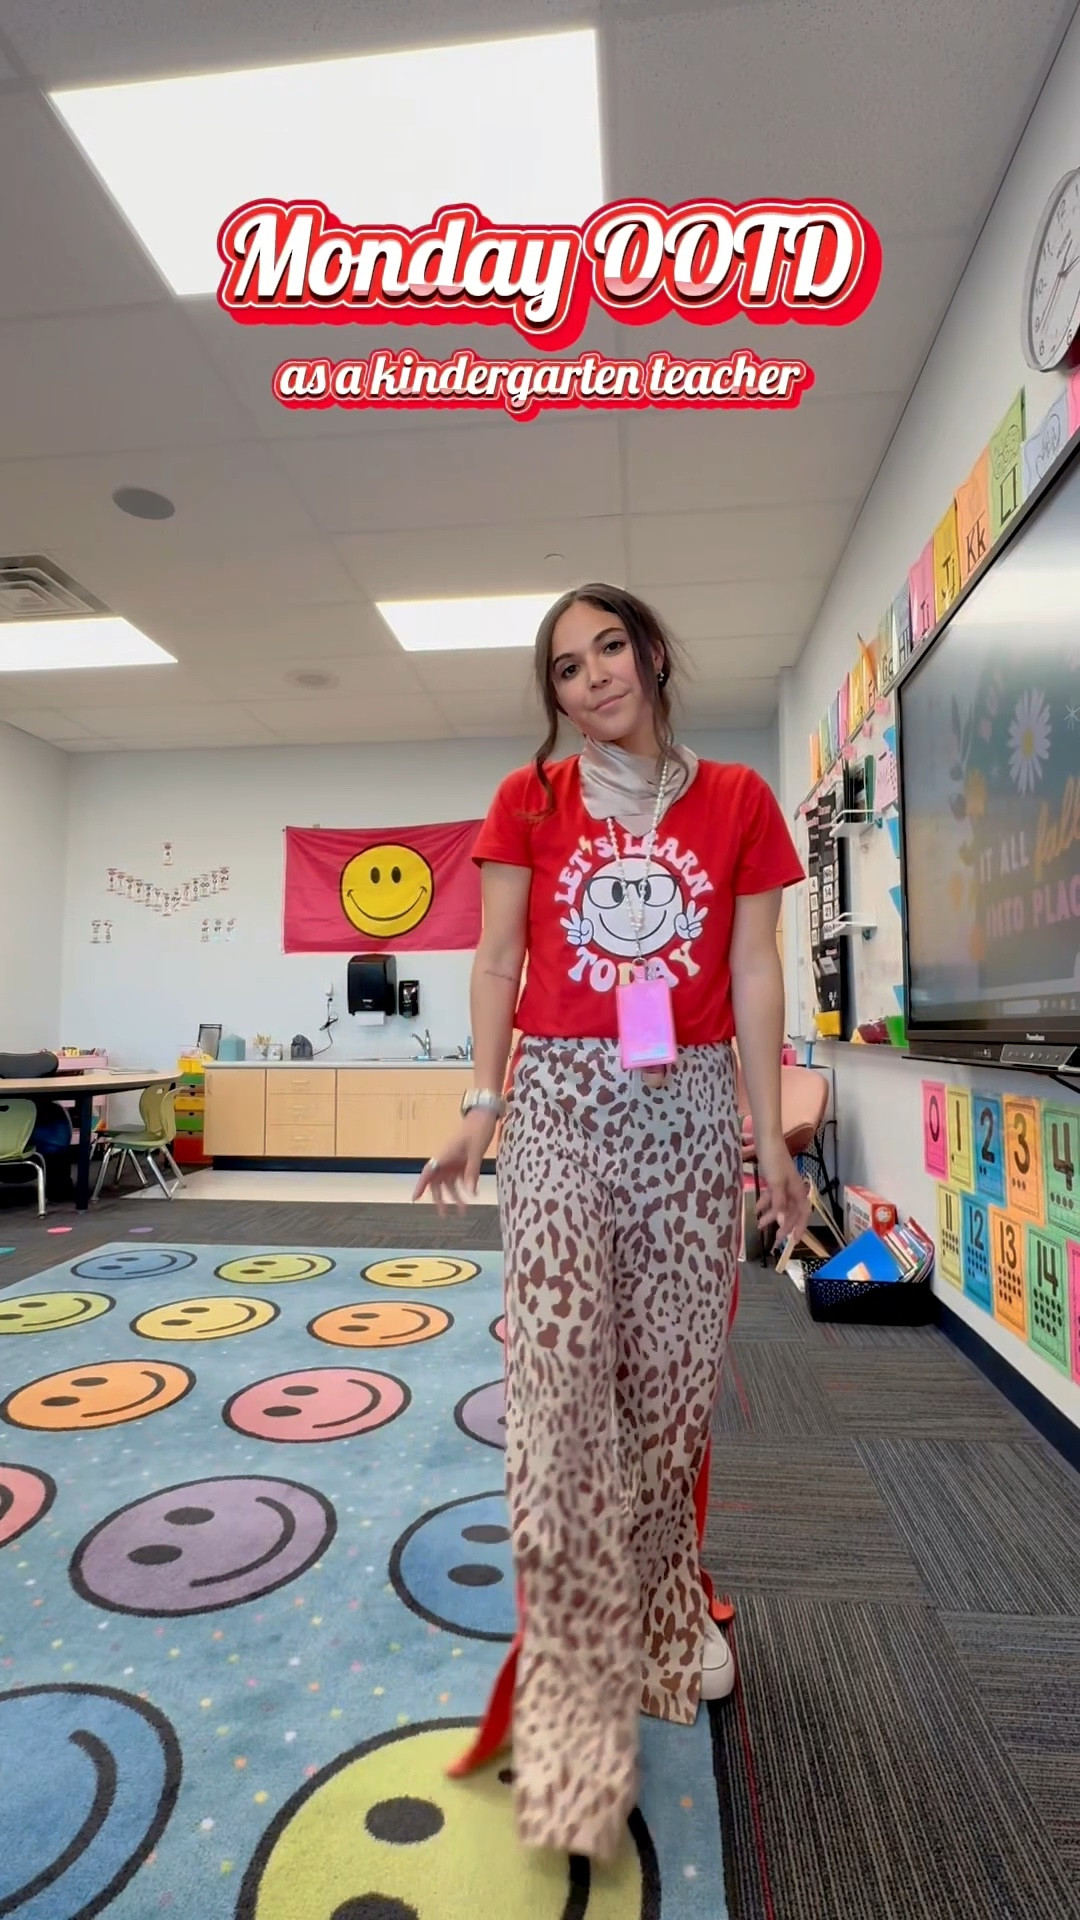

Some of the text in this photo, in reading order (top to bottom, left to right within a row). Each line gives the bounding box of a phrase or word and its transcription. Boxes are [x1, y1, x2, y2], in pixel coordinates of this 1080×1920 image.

[966, 511, 986, 573] Kk
[941, 552, 956, 600] Jj
[554, 833, 713, 905] LET'S LEARN
[1000, 831, 1030, 876] ALL
[986, 895, 1025, 938] INTO
[928, 1094, 940, 1142] 0
[956, 1100, 962, 1151] 1
[979, 1106, 995, 1163] 2
[1013, 1112, 1031, 1174] 3
[1051, 1121, 1075, 1192] 4
[945, 1193, 954, 1232] 11
[969, 1205, 985, 1251] 12
[999, 1220, 1017, 1269] 13
[1036, 1239, 1059, 1297] 14
